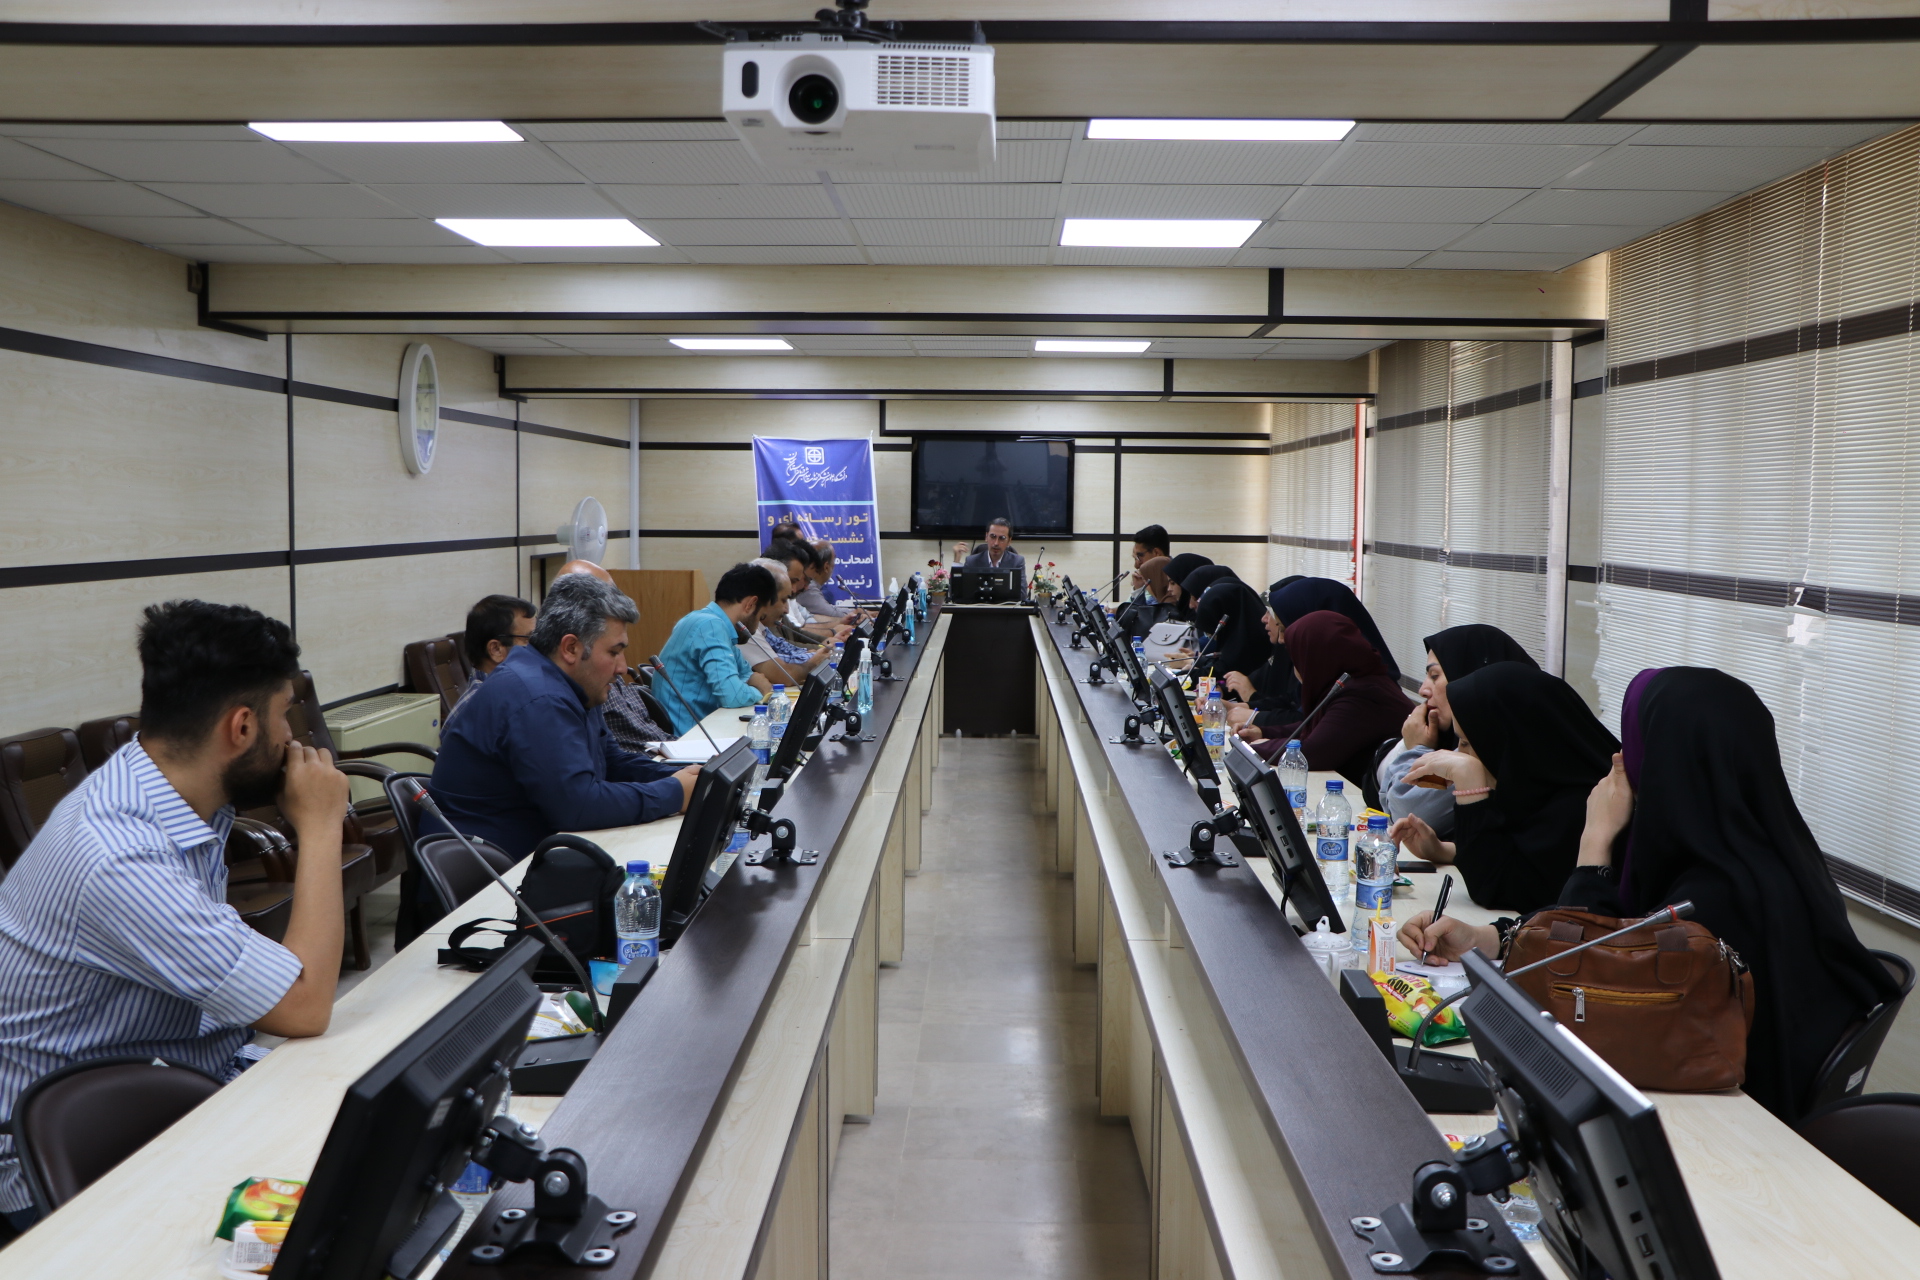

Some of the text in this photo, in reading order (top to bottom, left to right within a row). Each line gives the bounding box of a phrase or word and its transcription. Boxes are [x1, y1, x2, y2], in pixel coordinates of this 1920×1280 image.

[767, 515, 775, 527] و
[797, 512, 842, 526] رسانه
[845, 512, 869, 526] تور
[841, 554, 874, 568] اصحاب
